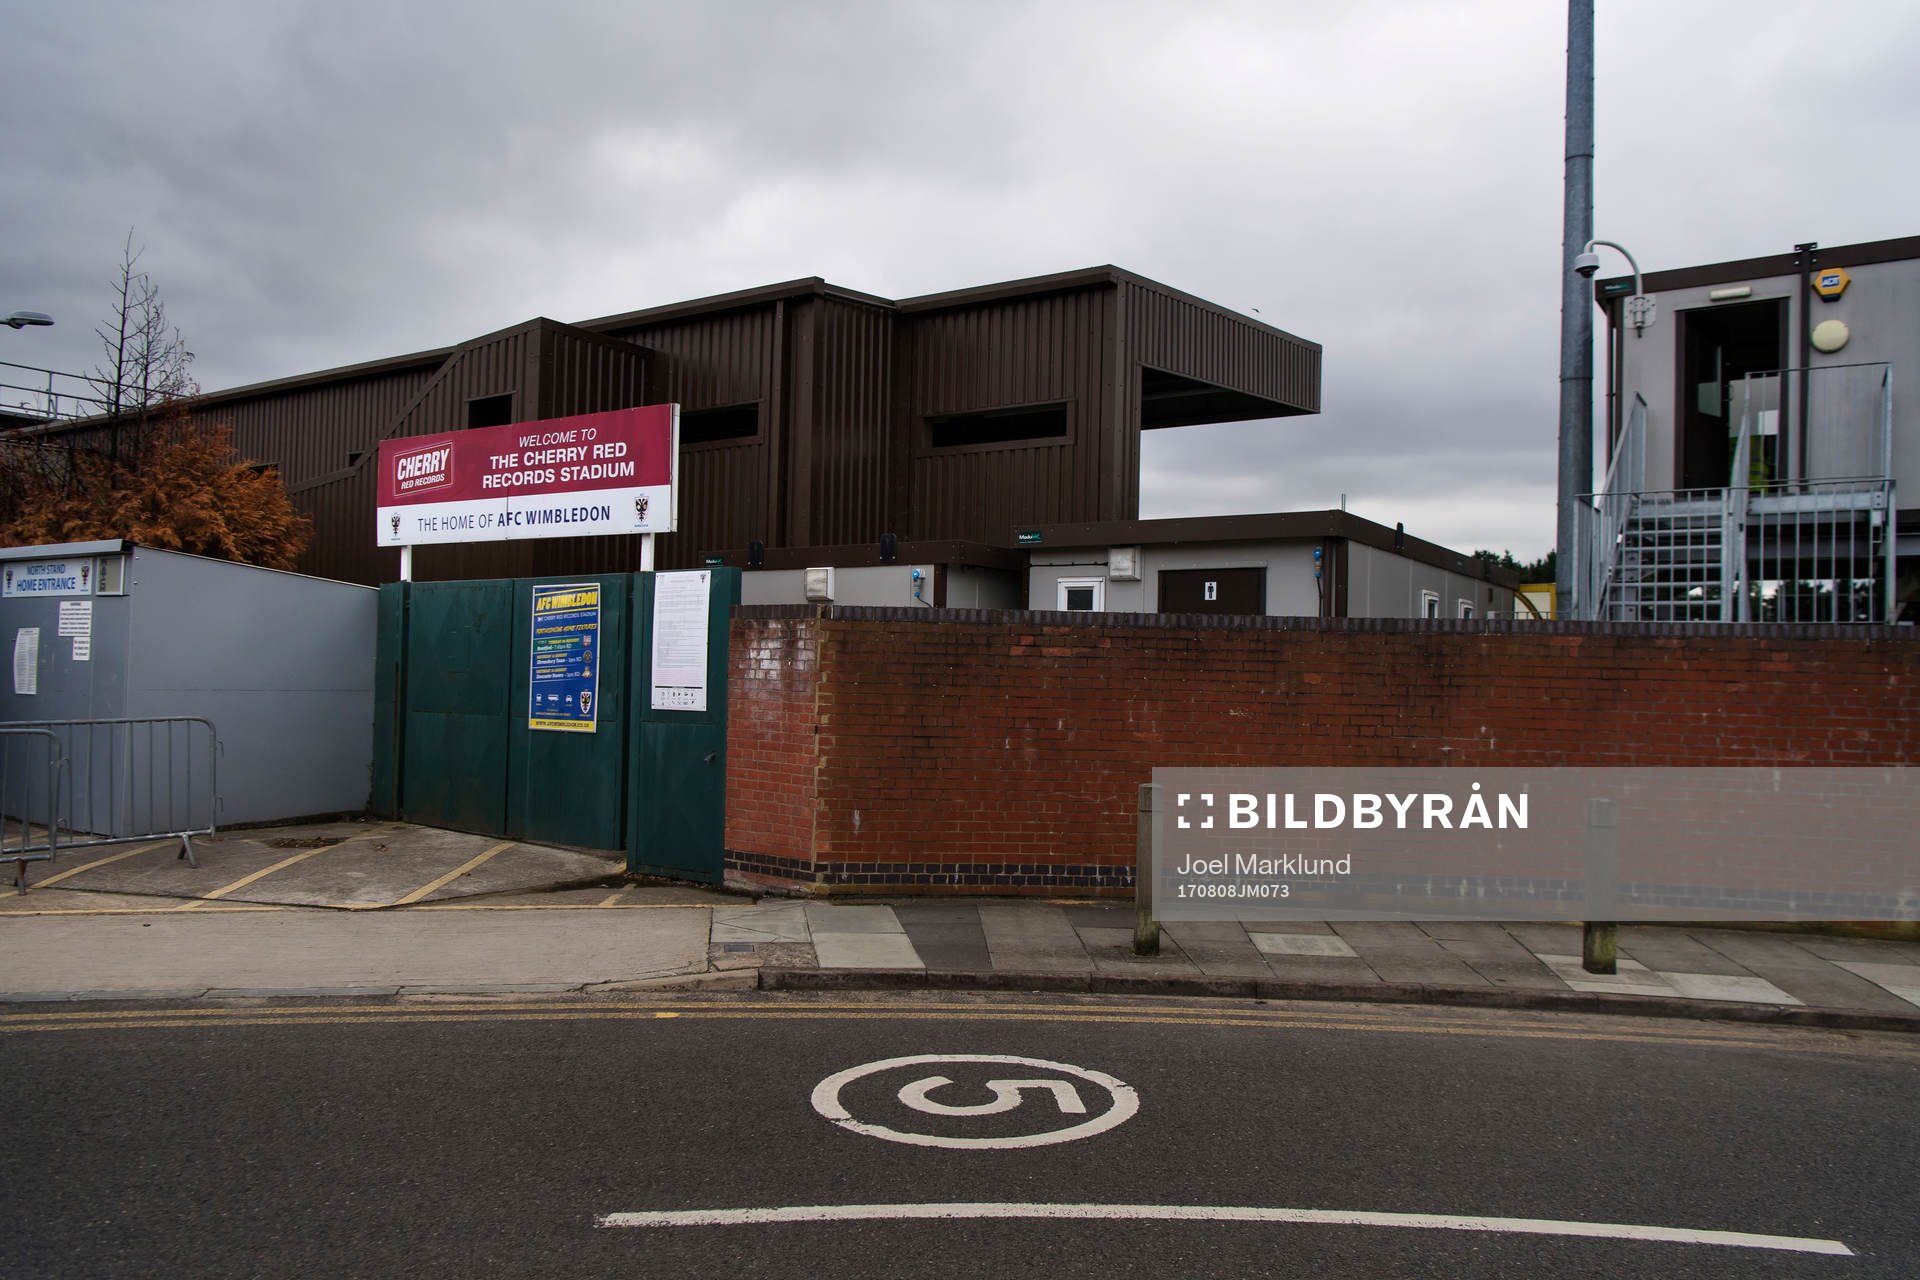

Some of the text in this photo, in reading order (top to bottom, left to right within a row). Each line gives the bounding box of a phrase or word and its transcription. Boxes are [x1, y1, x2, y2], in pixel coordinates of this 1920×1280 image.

[519, 428, 597, 447] WELCOME TO
[397, 448, 450, 480] CHERRY
[490, 442, 627, 469] THE CHERRY RED
[401, 473, 446, 490] RED RECORDS
[482, 461, 635, 489] RECORDS STADIUM
[418, 505, 611, 532] THE HOME OF AFC WIMBLEDON
[27, 563, 65, 575] NORTH STAND
[16, 577, 76, 592] HOME ENTRANCE
[536, 591, 598, 611] AFC WIMBLEDON
[897, 1075, 1087, 1117] 5
